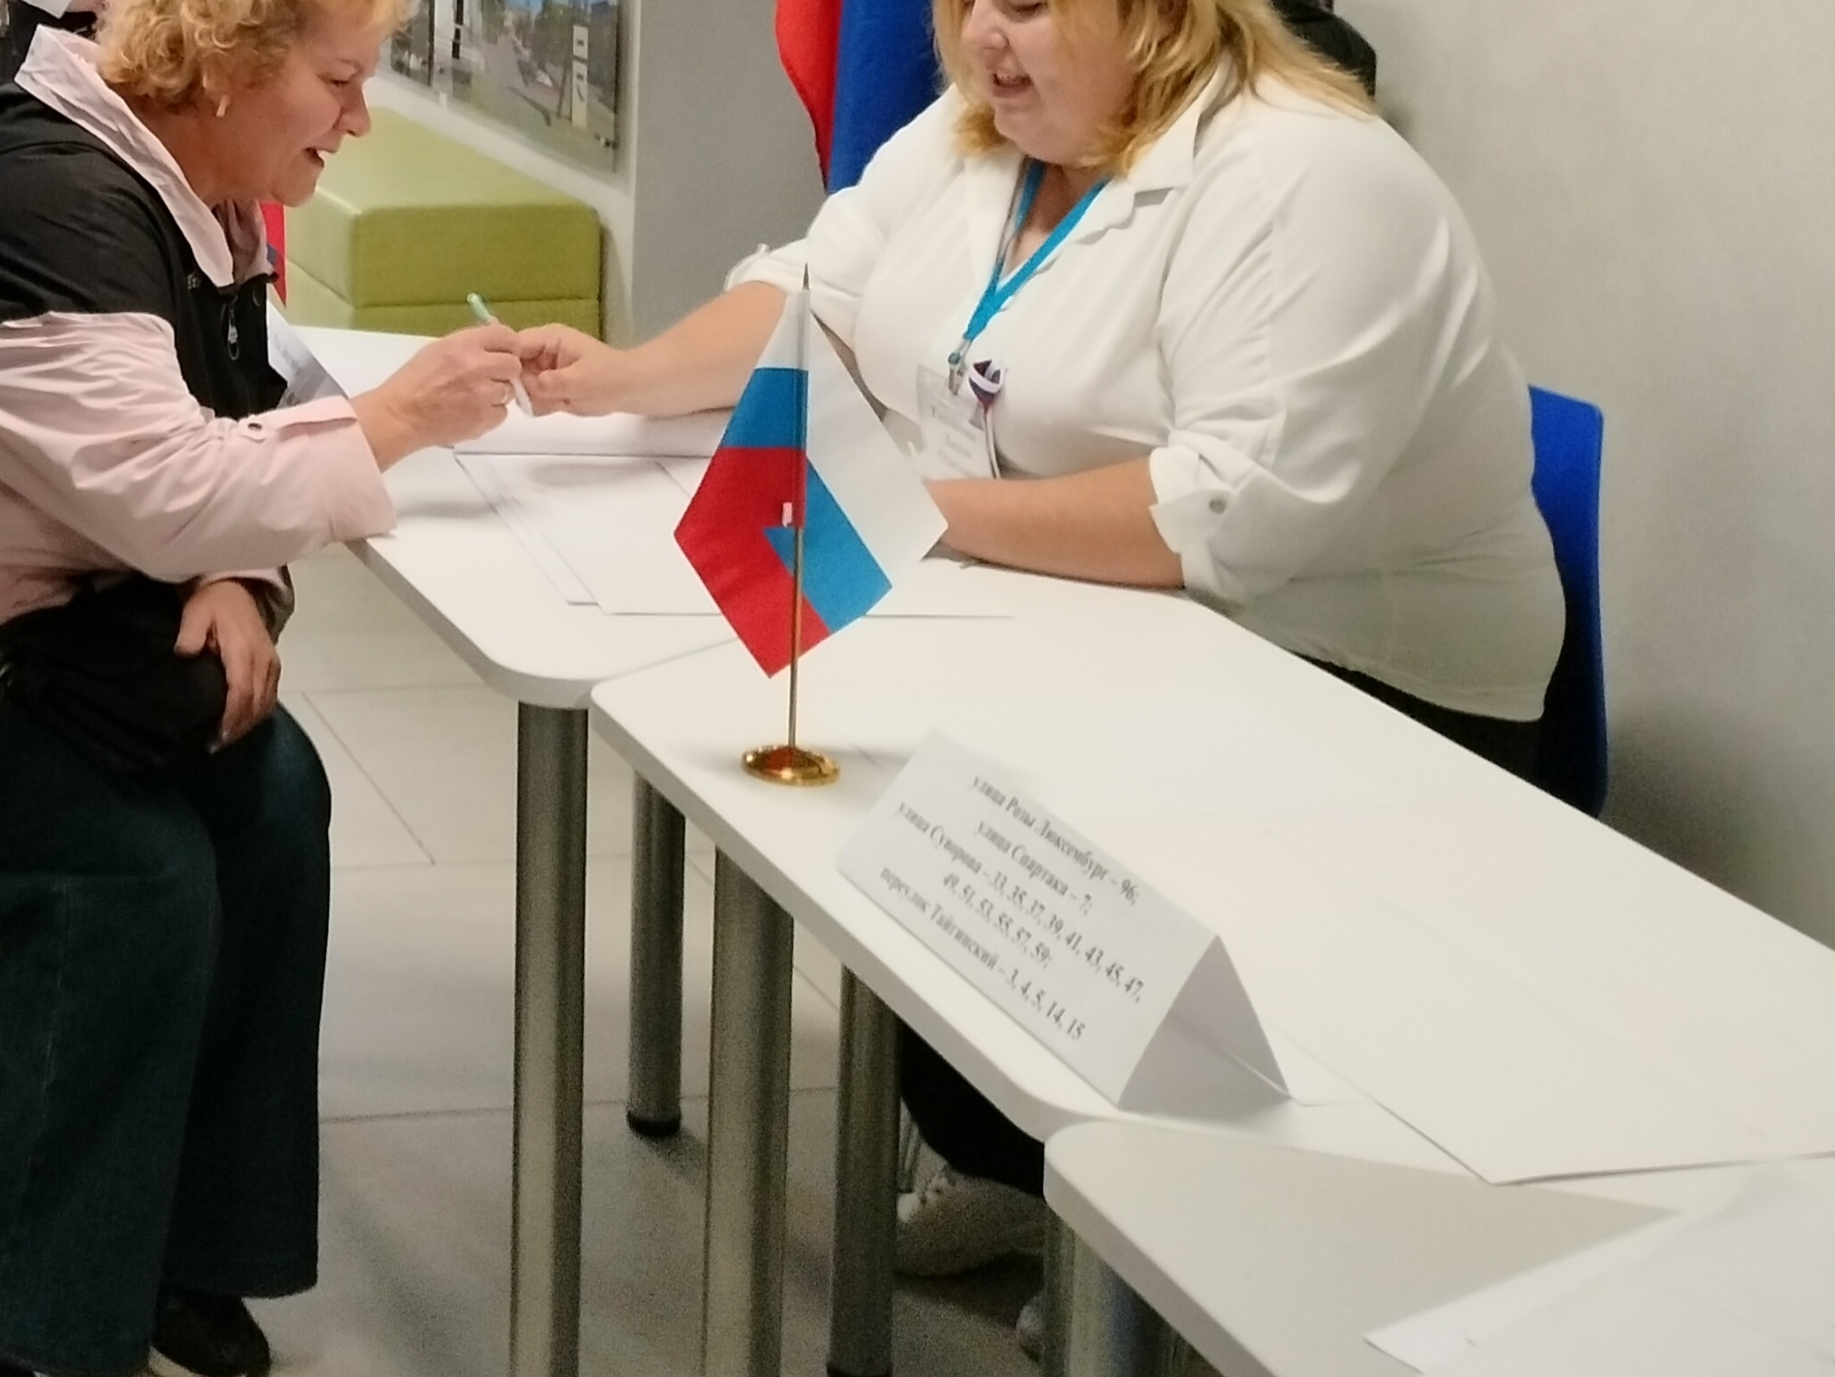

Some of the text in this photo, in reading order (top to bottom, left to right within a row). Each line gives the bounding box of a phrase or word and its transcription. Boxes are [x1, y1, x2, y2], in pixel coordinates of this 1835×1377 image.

[896, 802, 930, 835] улица
[930, 826, 981, 874] Суворова
[1007, 886, 1027, 908] 35,
[1026, 900, 1045, 924] 37,
[1049, 914, 1063, 939] 39,
[1066, 932, 1082, 954] 41,
[1085, 947, 1103, 969] 43,
[1106, 963, 1123, 985] 45,
[1125, 978, 1143, 1002] 47,
[972, 776, 1006, 807] улица
[1006, 797, 1036, 828] Розы
[1038, 818, 1110, 882] Люксембург
[1120, 878, 1140, 906] 96;
[975, 821, 1011, 855] улица
[1012, 845, 1068, 896] Спартака
[1081, 893, 1093, 917] 7;
[880, 868, 930, 913] переулок
[931, 904, 998, 970] Тайгинский
[1007, 969, 1018, 989] 3,
[1021, 982, 1031, 1000] 4,
[1032, 990, 1045, 1012] 5,
[1046, 1002, 1065, 1027] 14,
[1067, 1019, 1085, 1038] 15
[960, 884, 975, 908] 51,
[977, 898, 994, 922] 53,
[998, 913, 1013, 936] 55,
[1012, 927, 1031, 952] 57,
[1032, 942, 1051, 968] 59;
